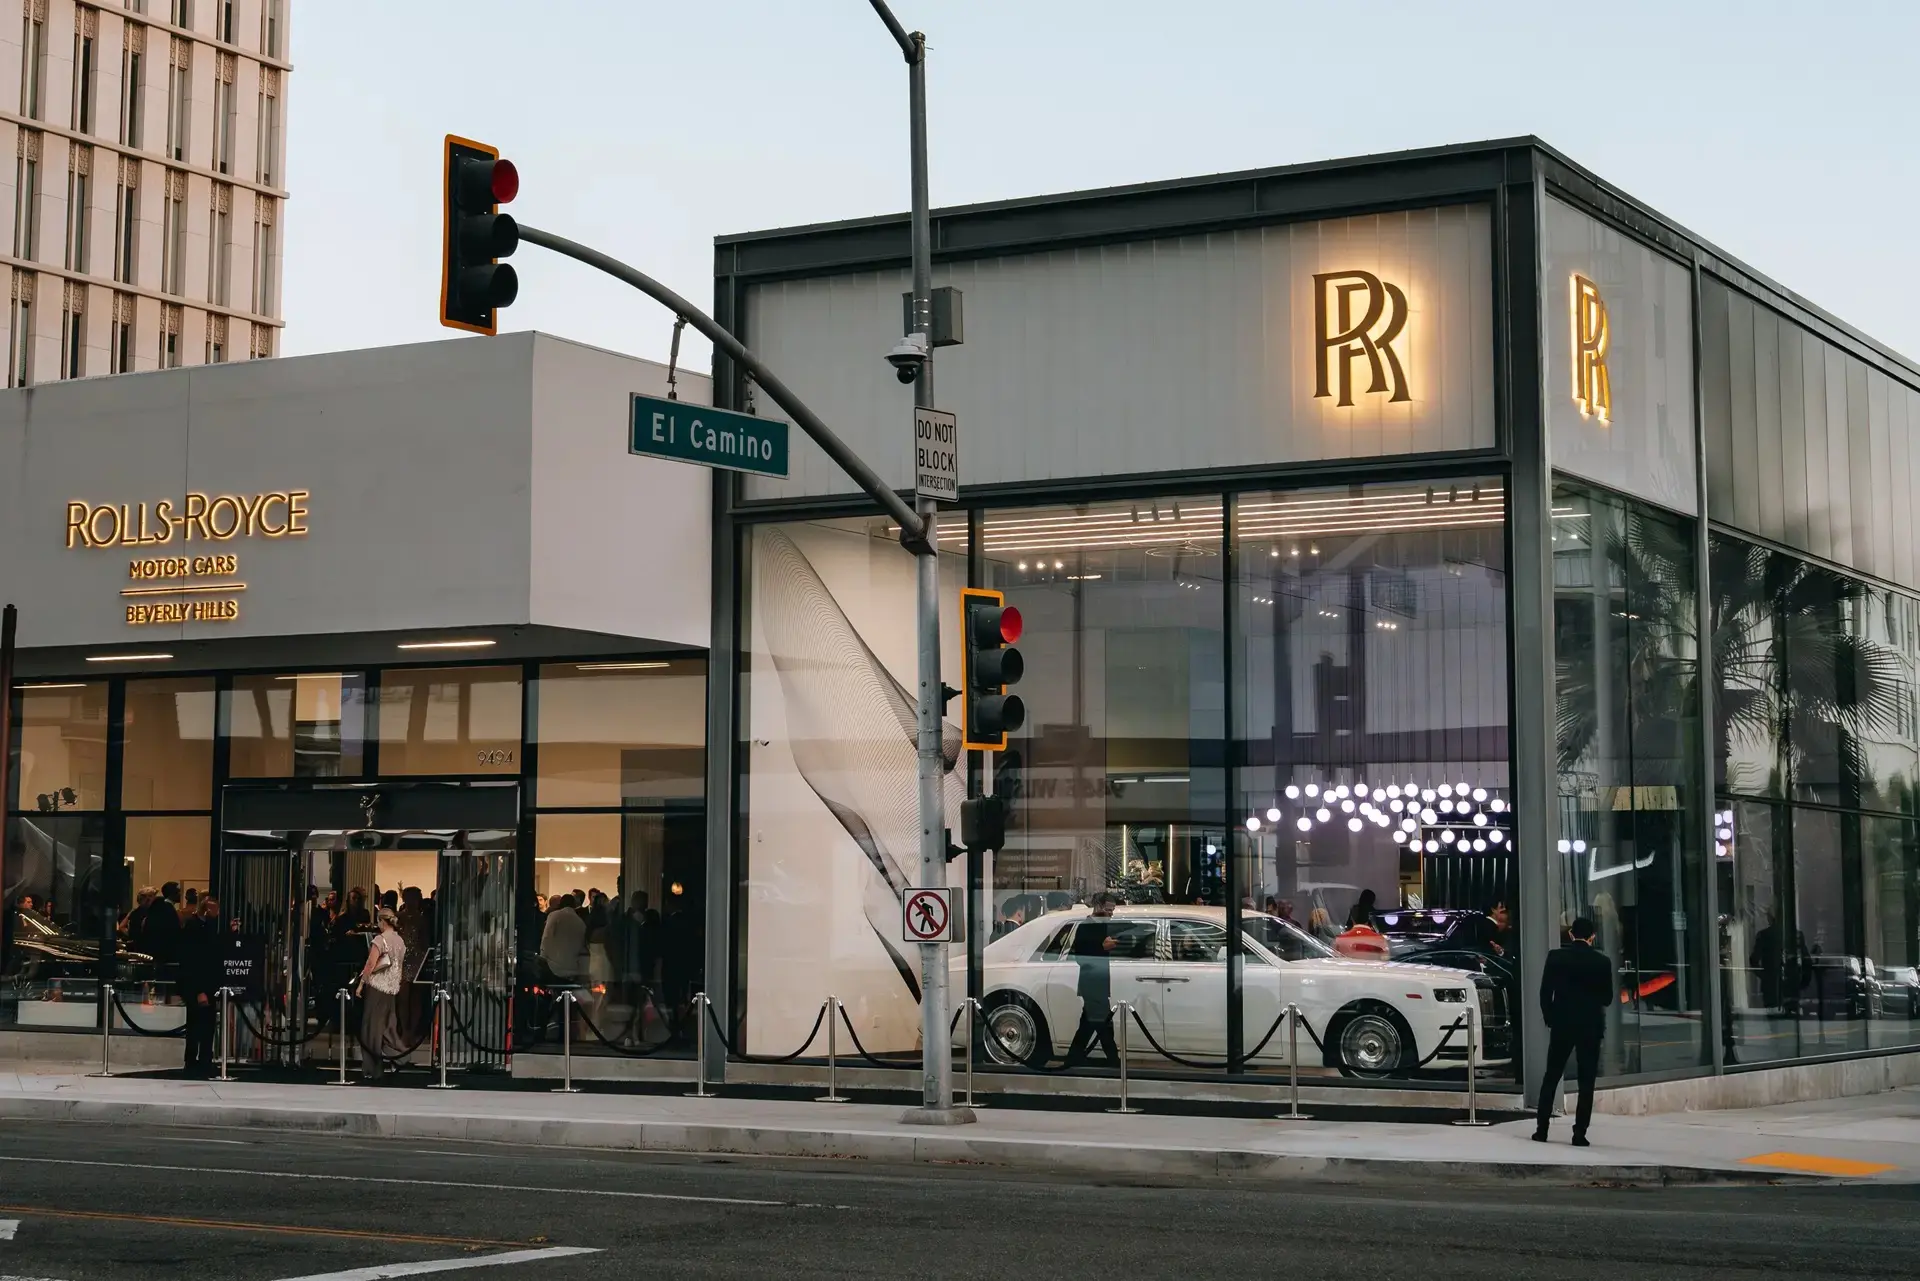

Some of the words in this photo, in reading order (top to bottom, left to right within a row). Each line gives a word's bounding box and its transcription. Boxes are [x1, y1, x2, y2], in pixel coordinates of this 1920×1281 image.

[652, 412, 675, 444] El
[690, 419, 772, 461] Camino
[918, 419, 932, 440] DO
[935, 422, 953, 444] NOT
[918, 448, 955, 472] BLOCK
[919, 474, 956, 492] INTERSECTION
[66, 491, 309, 547] ROLLS-ROYCE
[129, 558, 188, 578] MOTOR
[192, 555, 236, 575] CARS
[126, 603, 190, 623] BEVERLY
[192, 600, 237, 620] HILLS
[477, 749, 514, 767] 9494
